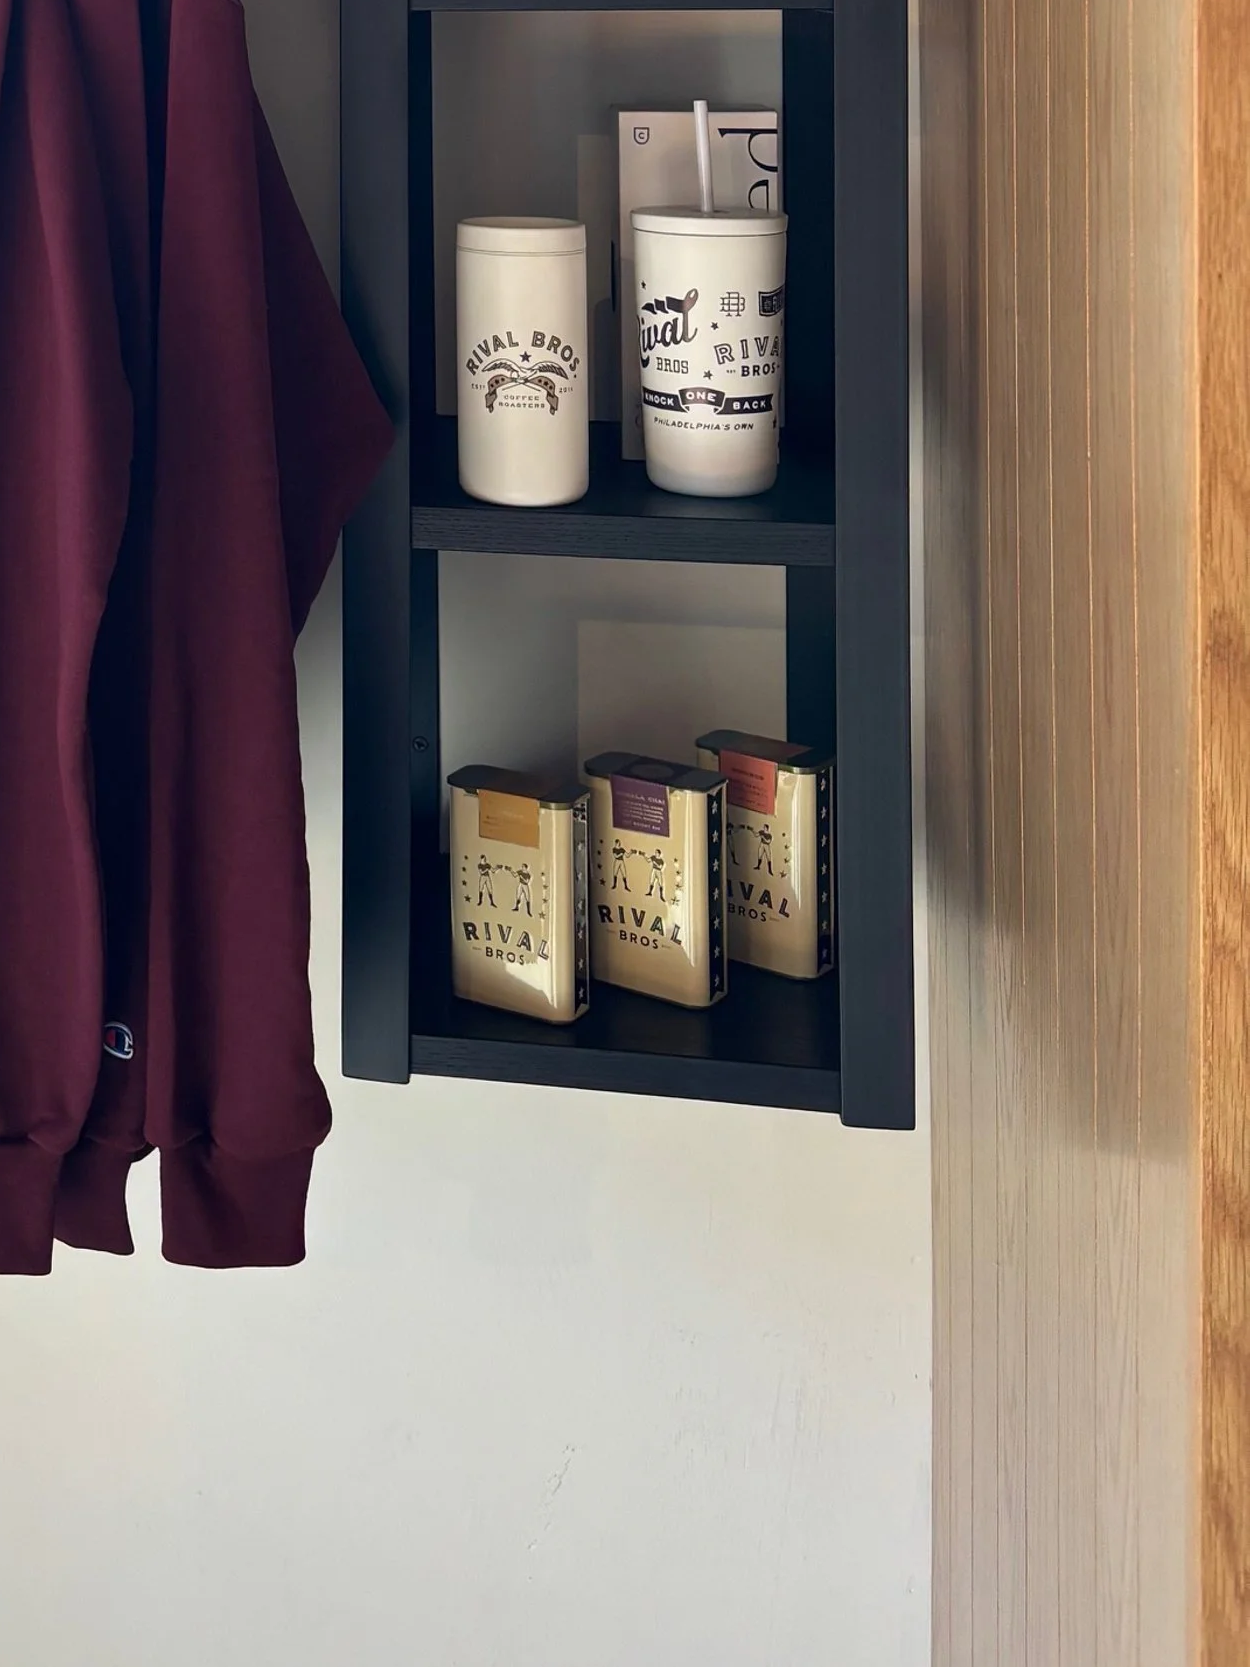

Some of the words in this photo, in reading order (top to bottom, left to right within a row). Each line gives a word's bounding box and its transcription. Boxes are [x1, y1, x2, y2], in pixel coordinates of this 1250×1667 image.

[466, 331, 519, 376] RIVAL
[713, 336, 780, 365] RIVA
[656, 356, 689, 375] BROS
[741, 362, 776, 377] BROS
[498, 401, 545, 409] ROASTERS
[645, 392, 674, 406] KNOCK
[685, 391, 717, 403] ONE
[732, 399, 766, 410] BACK
[653, 417, 730, 431] PHILADELPHIA'S
[733, 423, 754, 431] OWN
[726, 879, 791, 918] IVAL
[727, 902, 767, 922] BROS
[598, 904, 683, 946] RIVAL
[463, 921, 550, 961] RIVAL
[619, 929, 659, 950] BROS
[485, 946, 526, 966] BROS
